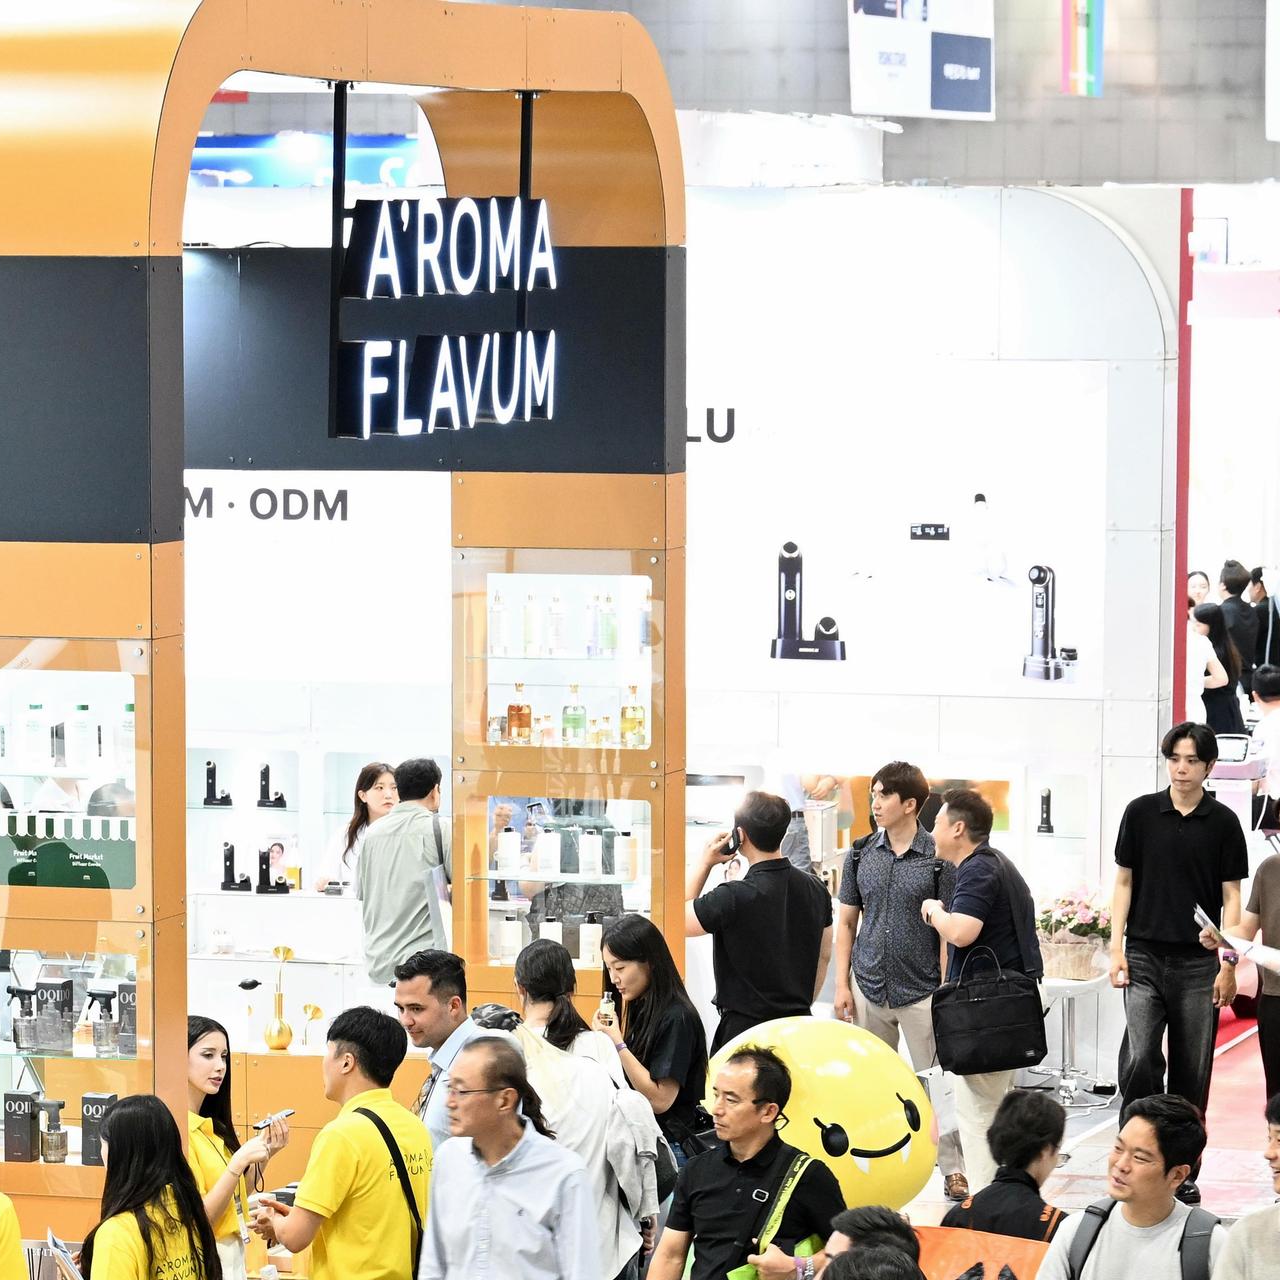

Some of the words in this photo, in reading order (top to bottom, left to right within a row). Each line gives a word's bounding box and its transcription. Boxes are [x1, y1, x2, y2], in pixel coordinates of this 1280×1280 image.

[366, 197, 557, 300] A'ROMA
[363, 329, 556, 438] FLAVUM
[249, 487, 348, 521] ODM
